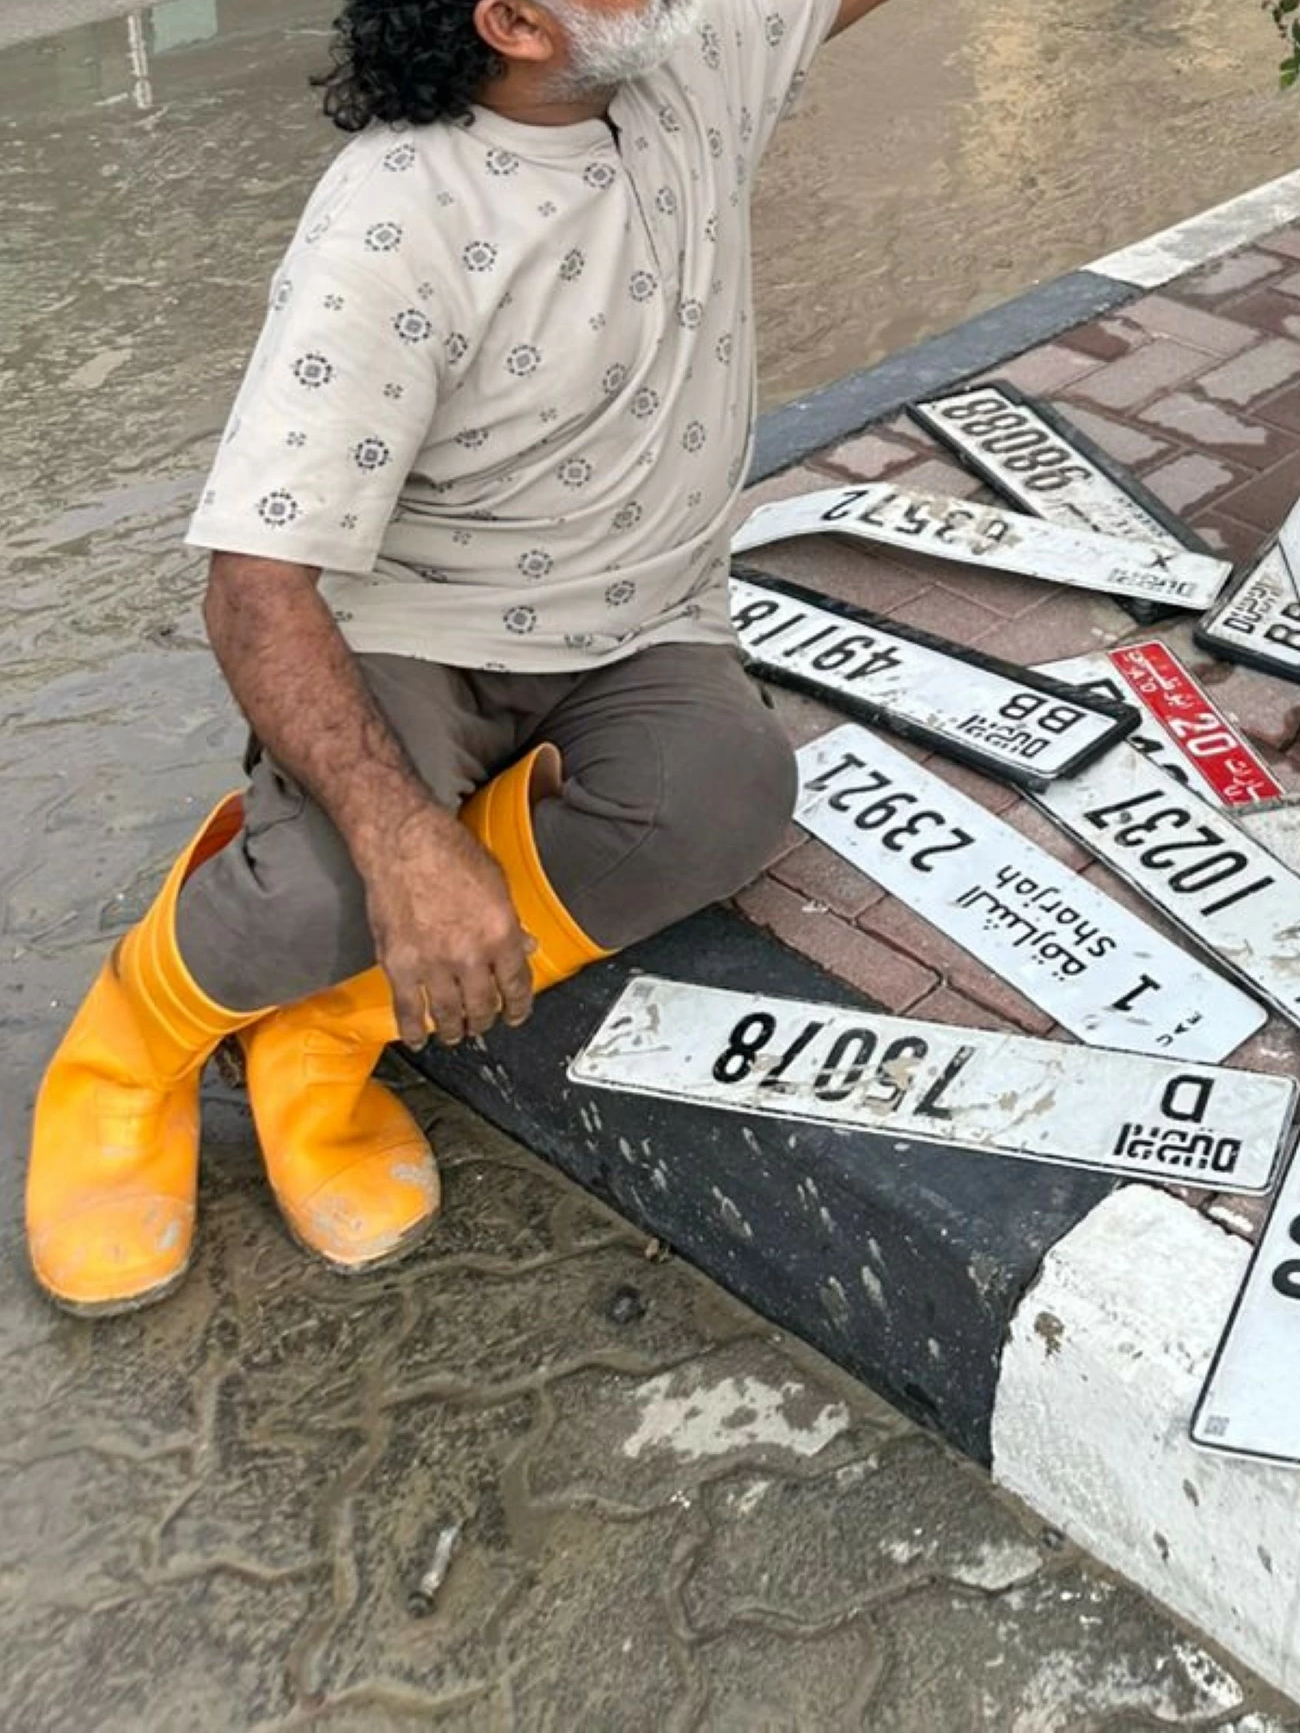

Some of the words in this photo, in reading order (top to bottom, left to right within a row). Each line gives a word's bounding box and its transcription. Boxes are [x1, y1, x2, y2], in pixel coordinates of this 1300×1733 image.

[941, 398, 1093, 492] 98088
[730, 598, 902, 682] 49118
[998, 691, 1087, 736] BB
[1168, 712, 1239, 758] 20
[802, 751, 976, 873] 23921
[1083, 789, 1275, 918] 10237
[954, 883, 1088, 982] الشارقة
[995, 863, 1118, 960] Sharjah
[1110, 973, 1162, 1013] 1
[1160, 1074, 1215, 1124] D
